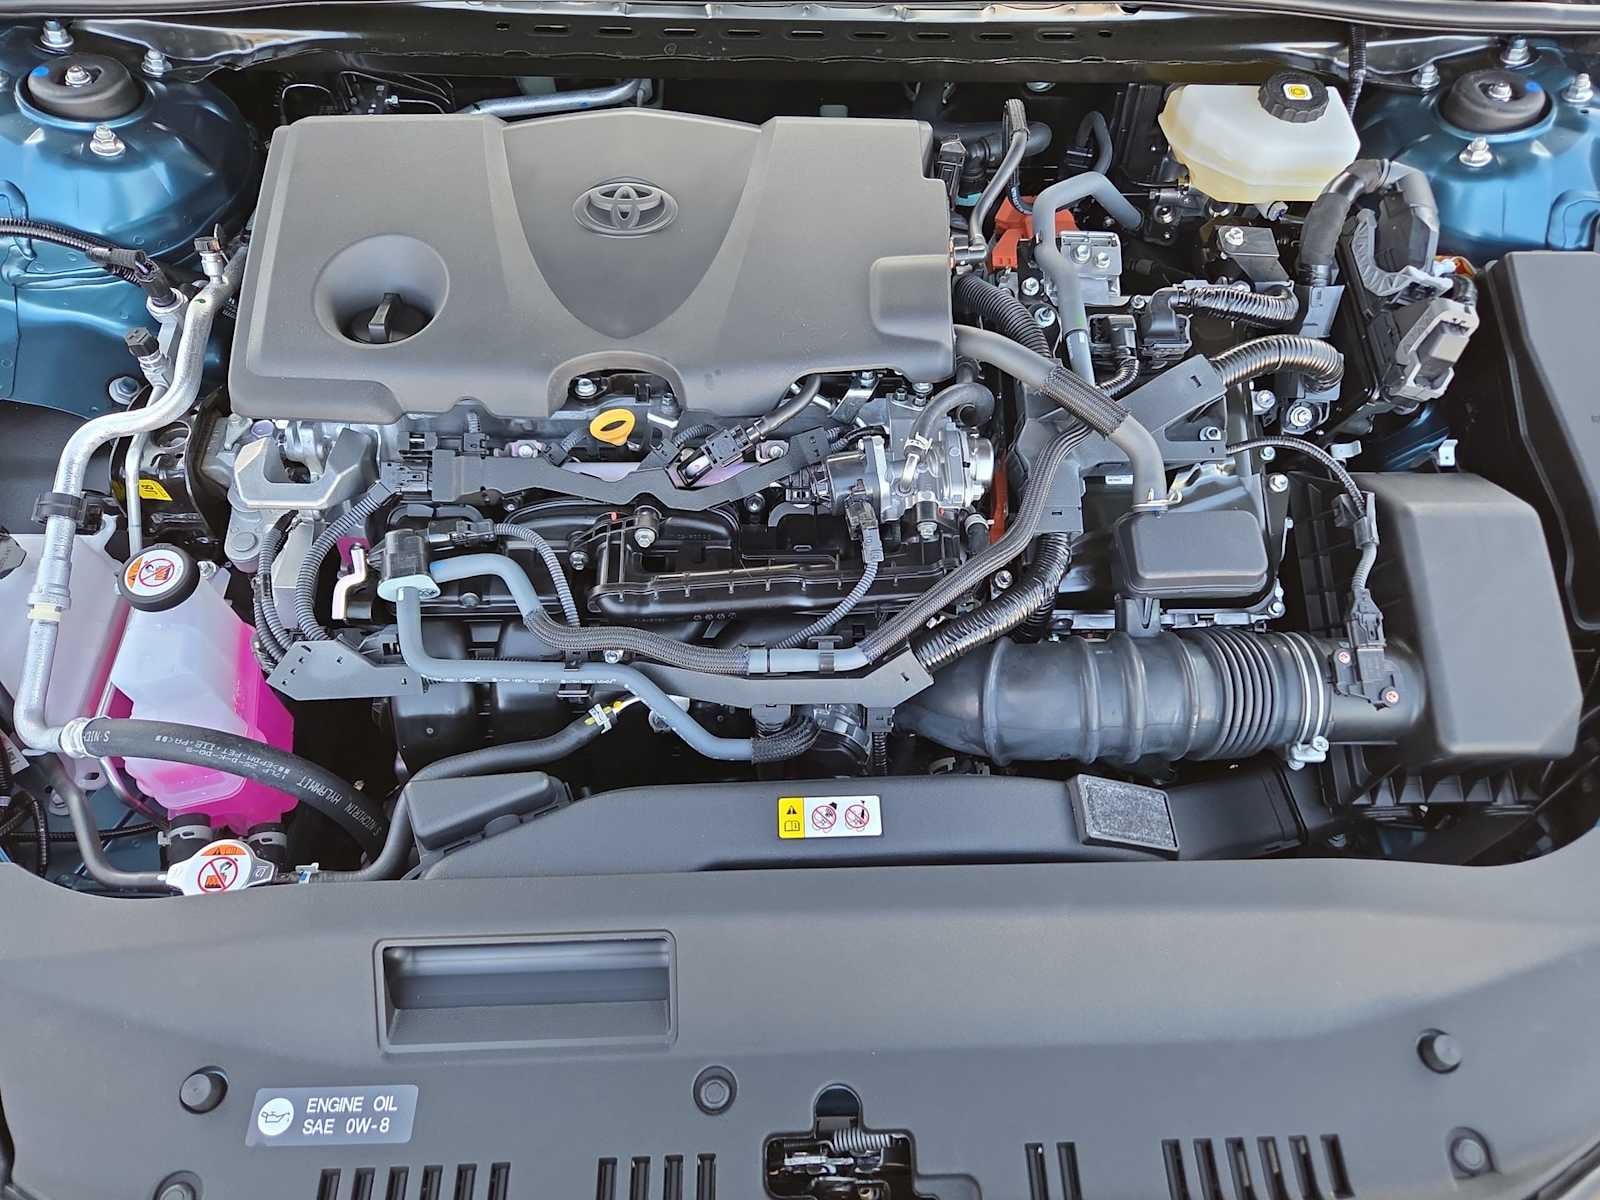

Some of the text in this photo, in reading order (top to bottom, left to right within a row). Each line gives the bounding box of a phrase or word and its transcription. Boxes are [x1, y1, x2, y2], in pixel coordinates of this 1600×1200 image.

[306, 1095, 398, 1113] ENGINE OIL
[302, 1117, 390, 1135] SAE 0W-8
